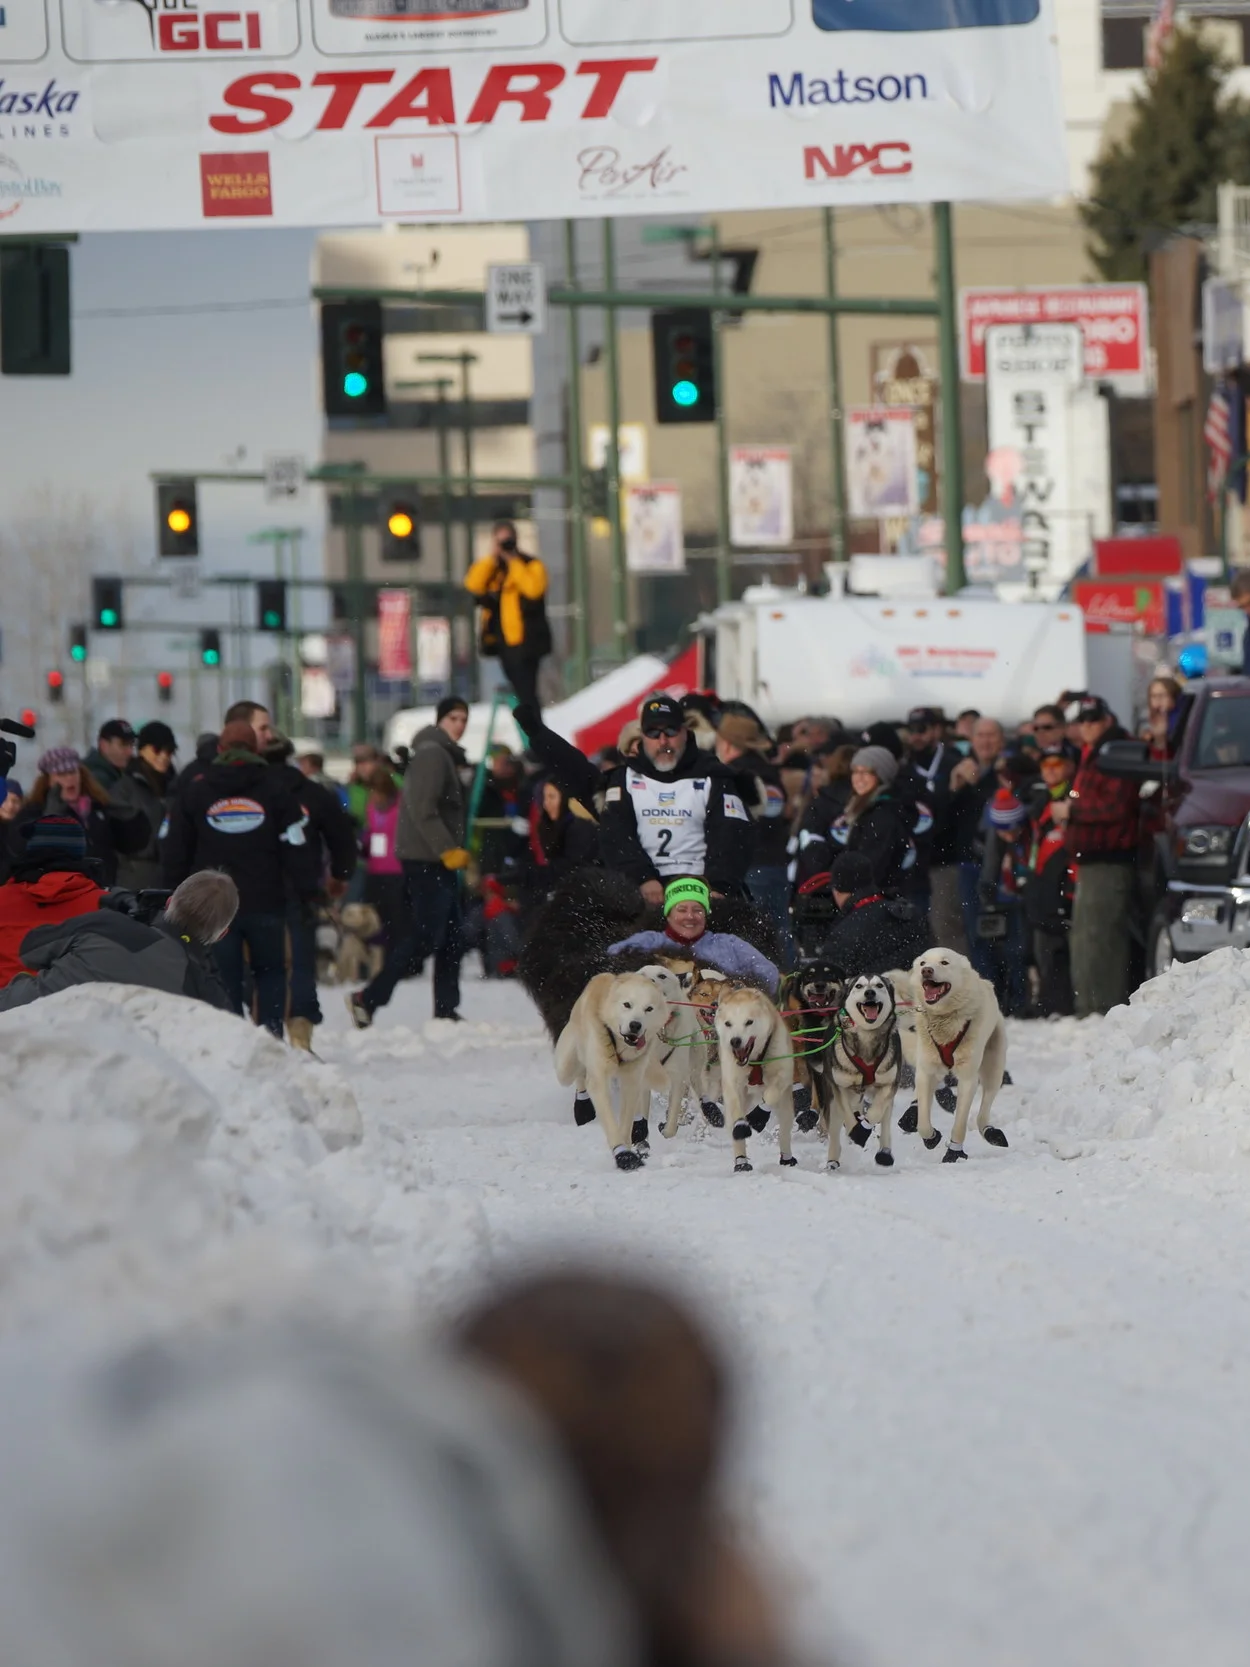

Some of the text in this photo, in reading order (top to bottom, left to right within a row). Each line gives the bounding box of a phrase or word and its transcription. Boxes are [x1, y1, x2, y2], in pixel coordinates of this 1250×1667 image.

[159, 12, 261, 51] GCI
[209, 57, 658, 134] START
[768, 69, 928, 108] Matson
[0, 123, 69, 138] INES
[803, 142, 912, 179] NAC
[207, 172, 269, 186] WELLS
[210, 186, 269, 200] FARGO
[642, 808, 693, 818] DONLIN
[649, 817, 685, 826] GOLD
[656, 828, 673, 857] 2
